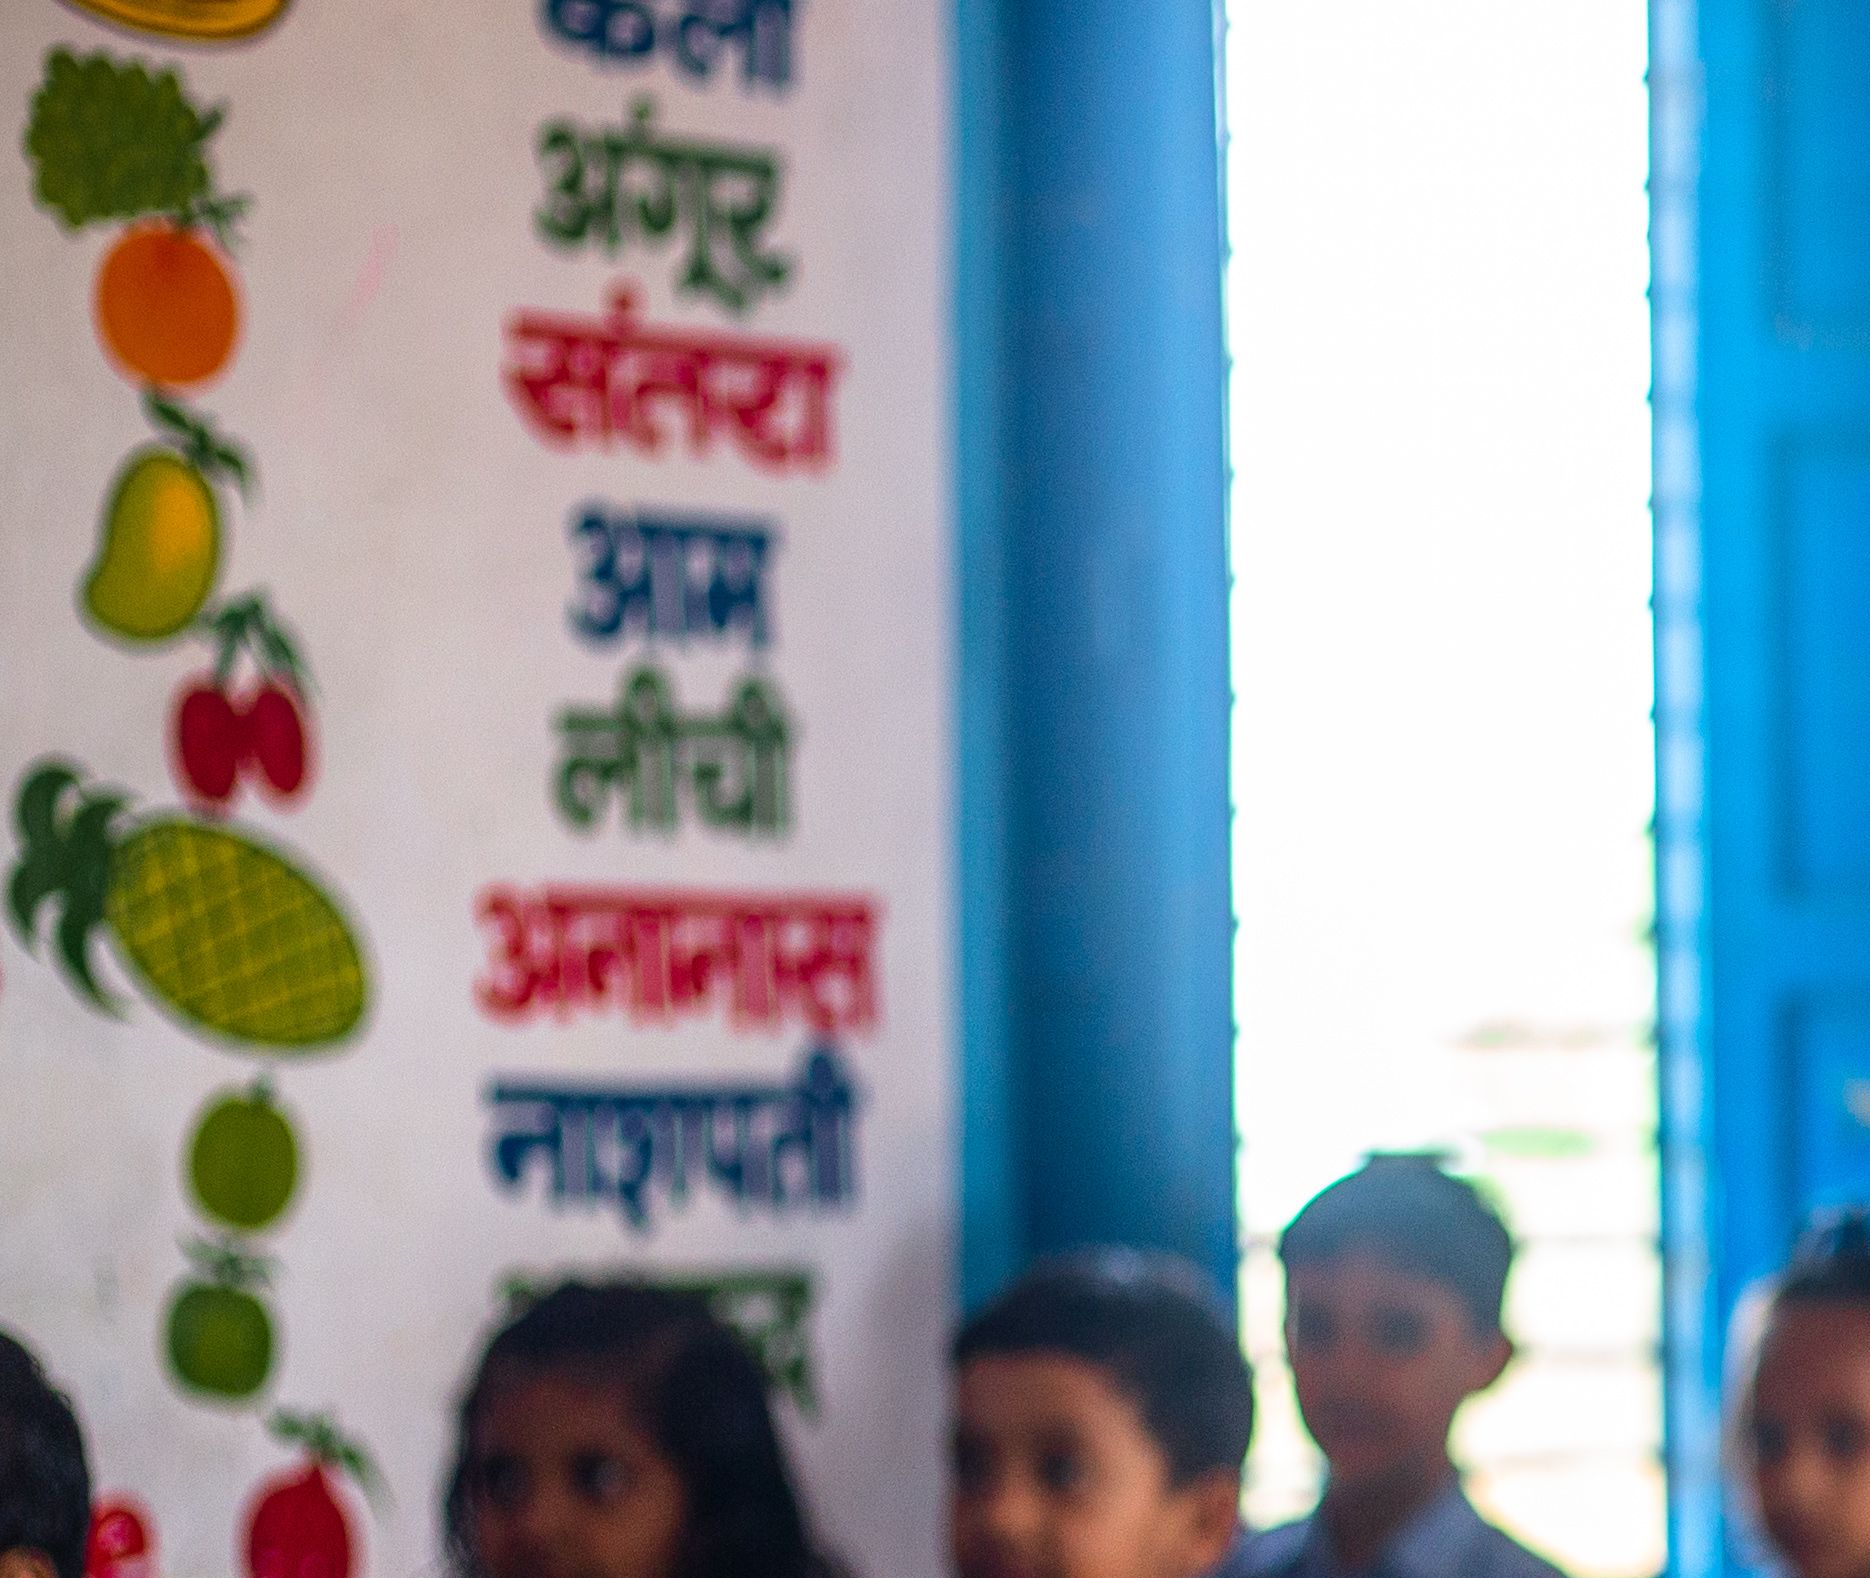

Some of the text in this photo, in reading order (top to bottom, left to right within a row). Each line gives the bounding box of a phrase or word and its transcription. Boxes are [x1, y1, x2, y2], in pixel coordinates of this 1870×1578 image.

[537, 94, 798, 312] अंगूर
[502, 280, 843, 474] संतरा
[570, 507, 780, 650] आम
[552, 665, 796, 837] लीची
[474, 882, 884, 1038] अनानास
